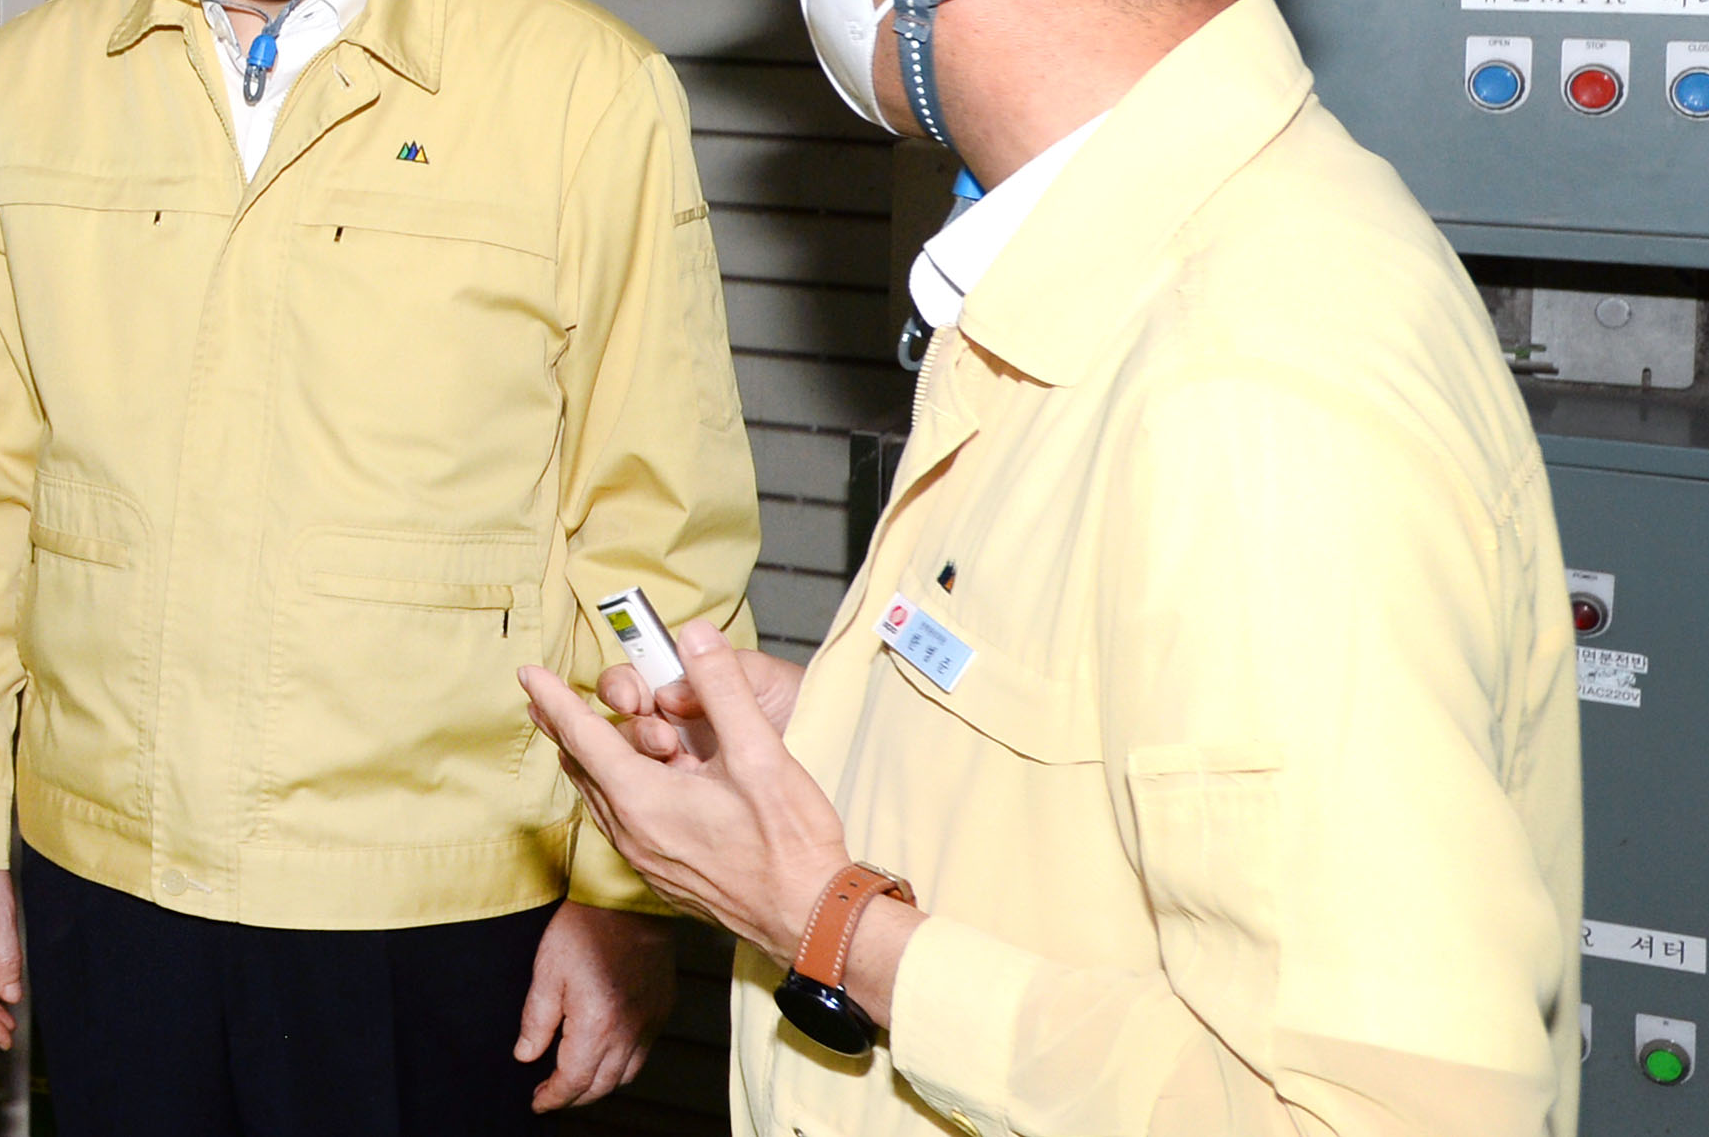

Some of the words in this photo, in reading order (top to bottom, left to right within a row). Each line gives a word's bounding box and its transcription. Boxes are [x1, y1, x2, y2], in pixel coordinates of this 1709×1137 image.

[1488, 38, 1511, 48] OPEN
[1585, 40, 1607, 51] STOP
[1630, 934, 1685, 965] 셔터
